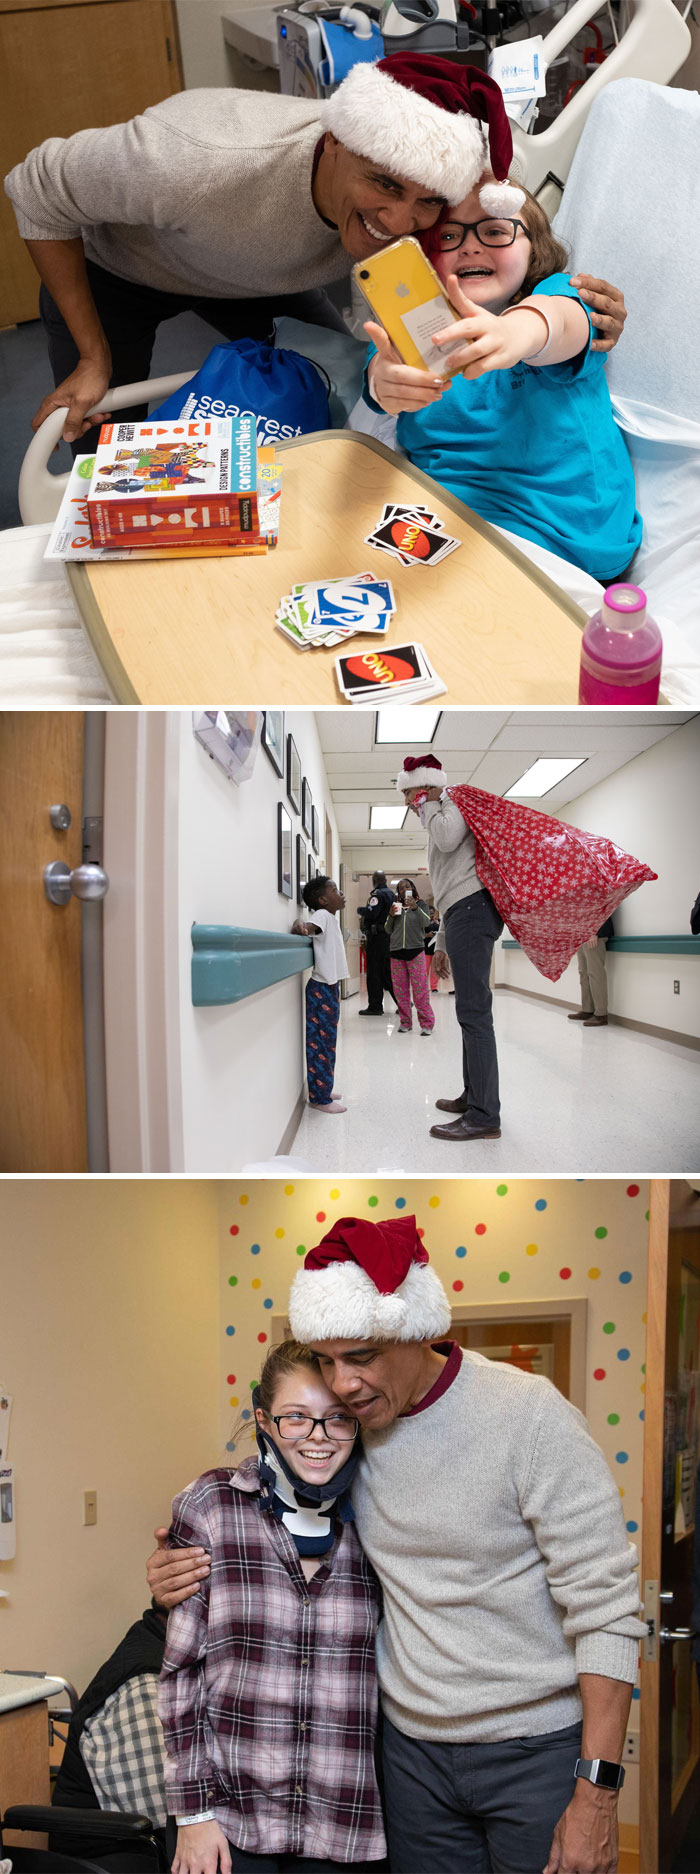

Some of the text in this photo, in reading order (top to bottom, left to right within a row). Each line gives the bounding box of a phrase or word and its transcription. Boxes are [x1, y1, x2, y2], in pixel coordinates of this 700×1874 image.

[117, 425, 127, 442] COOPER
[126, 424, 135, 442] HEWITT
[220, 448, 229, 472] PATTERNS
[238, 418, 251, 491] constructibles
[219, 471, 228, 491] DESIGN
[261, 468, 271, 478] 20
[398, 526, 421, 551] UNO
[342, 593, 369, 605] 7
[361, 653, 396, 684] UNO
